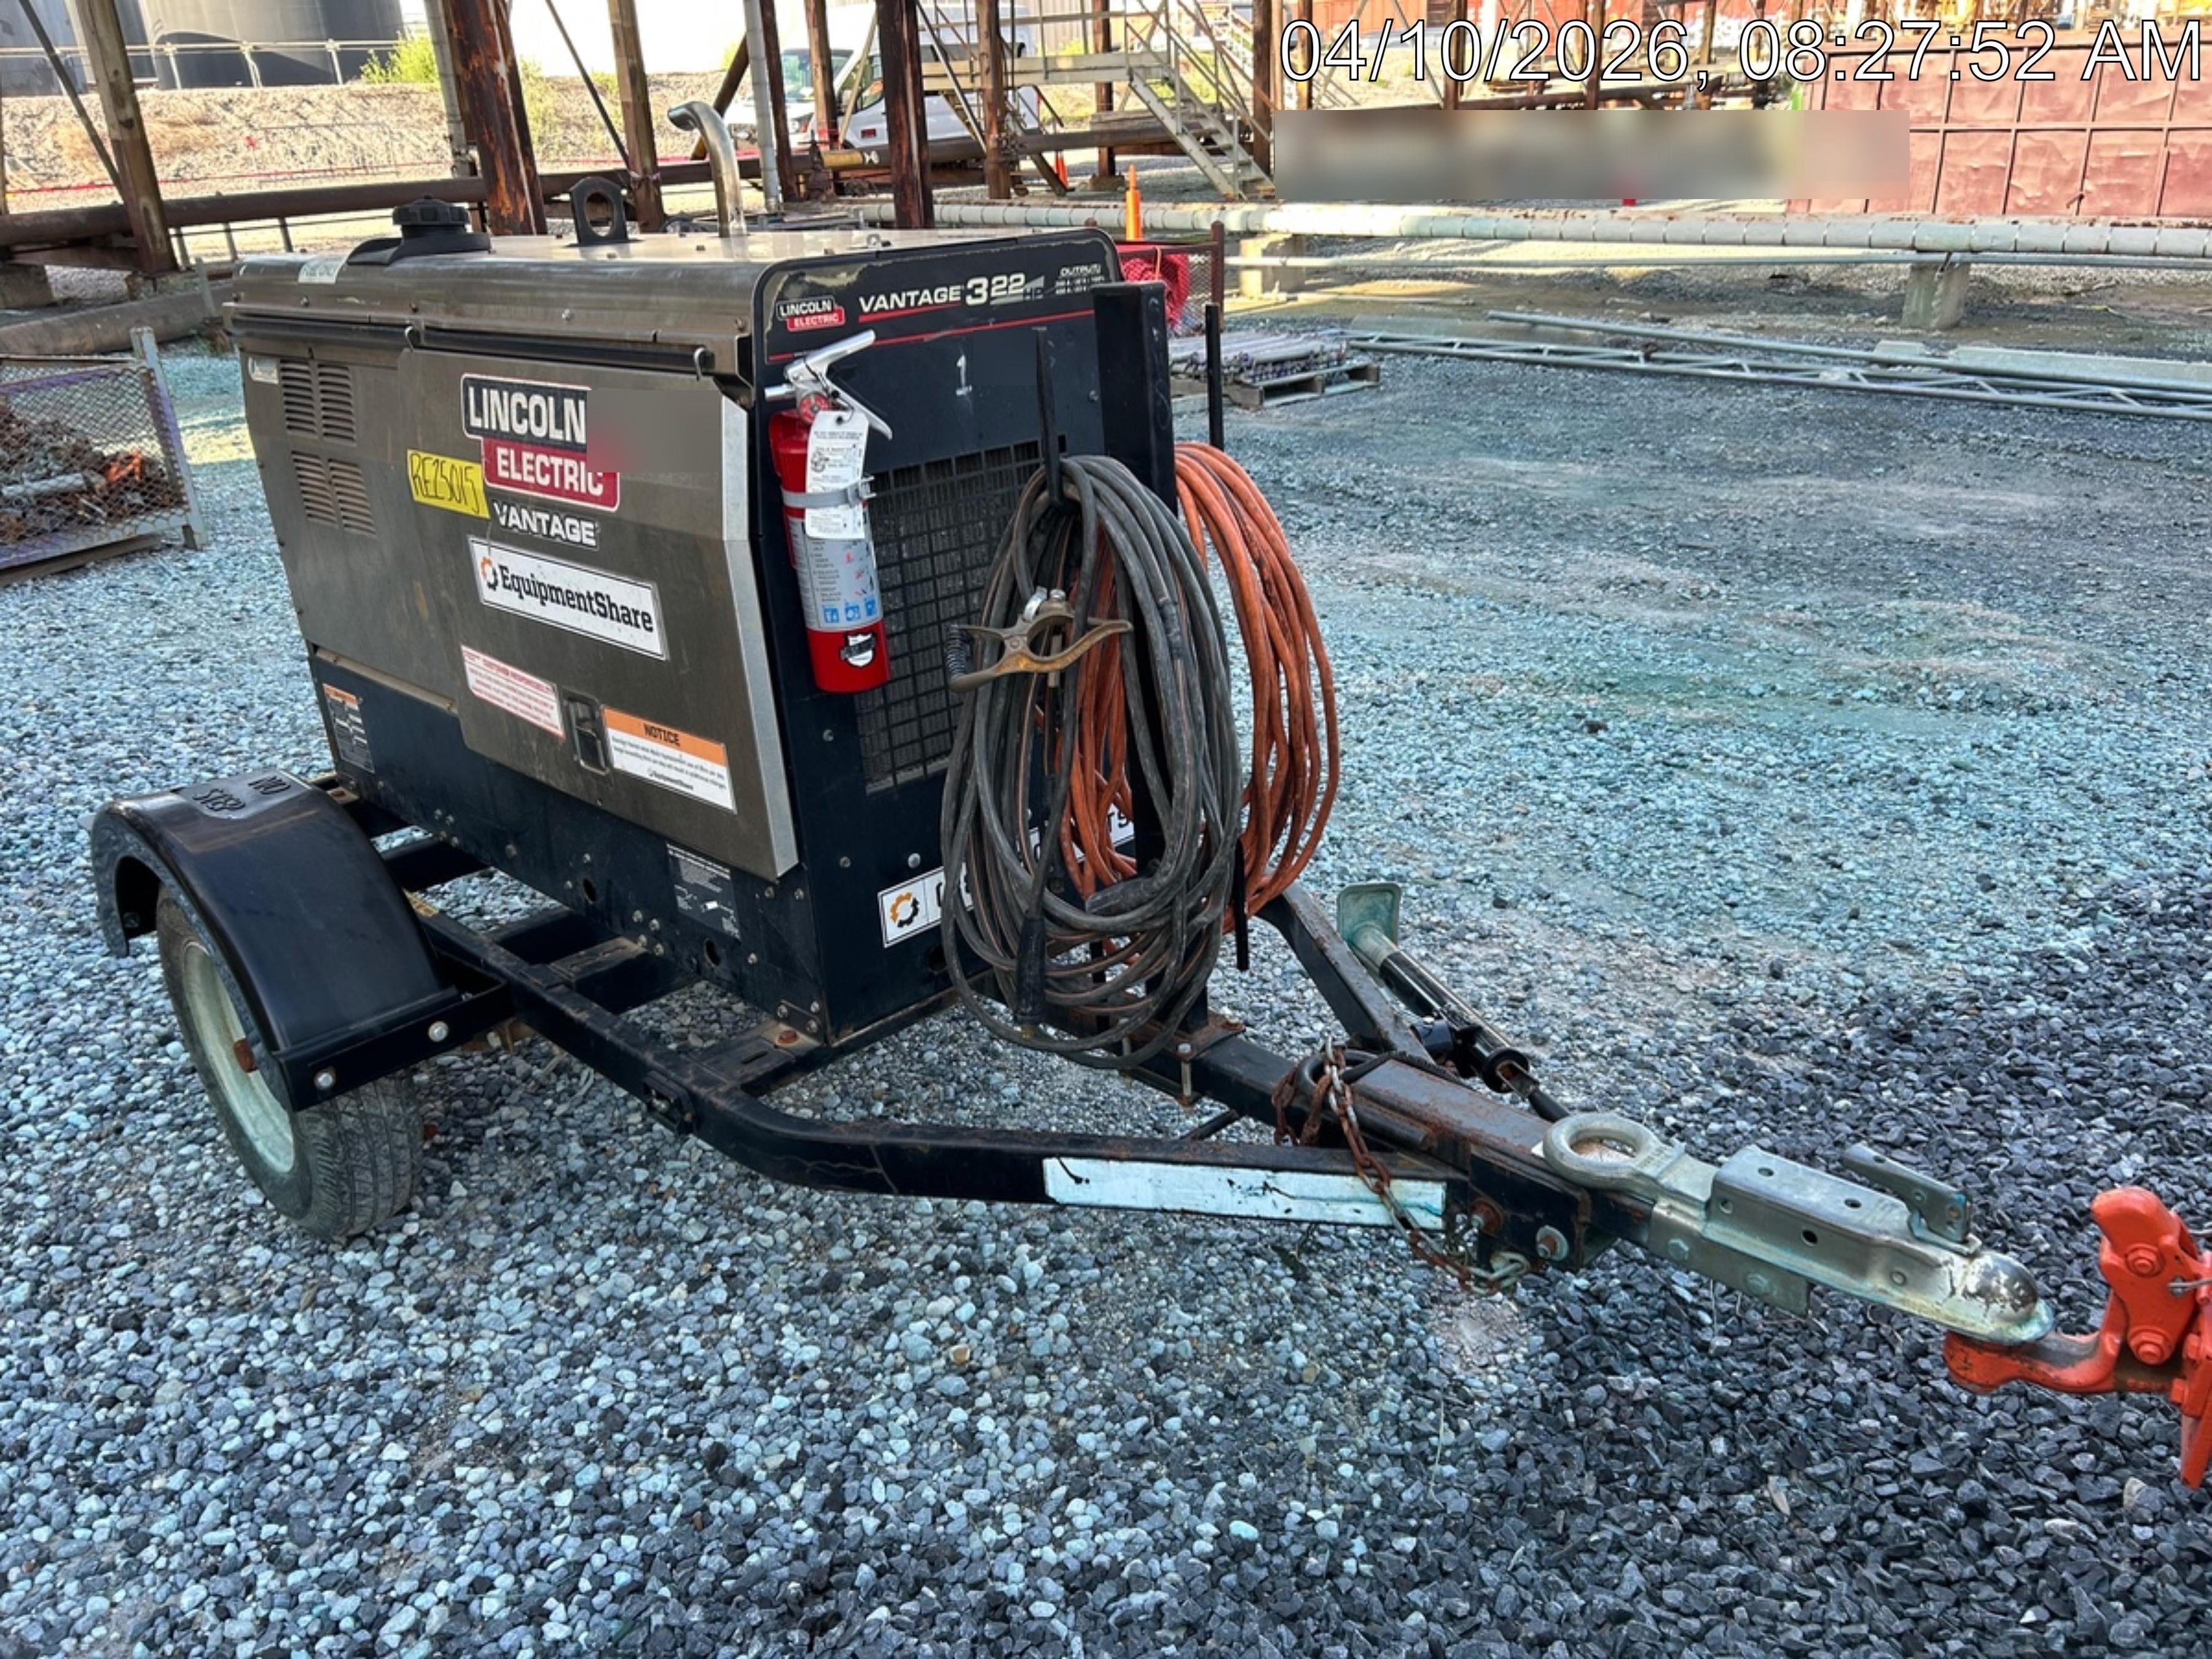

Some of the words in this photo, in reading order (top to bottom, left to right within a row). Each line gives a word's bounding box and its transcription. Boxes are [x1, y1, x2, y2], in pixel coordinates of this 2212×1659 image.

[779, 299, 833, 316] LINCOLN
[858, 284, 962, 313] VANTAGE
[965, 272, 1026, 305] 322
[793, 312, 839, 327] ELECTRIC
[468, 386, 587, 445] LINCOLN
[496, 446, 604, 496] ELECTRIC
[493, 501, 597, 547] VANTAGE
[499, 563, 654, 633] EquipmentShare
[643, 723, 681, 747] NOTICE
